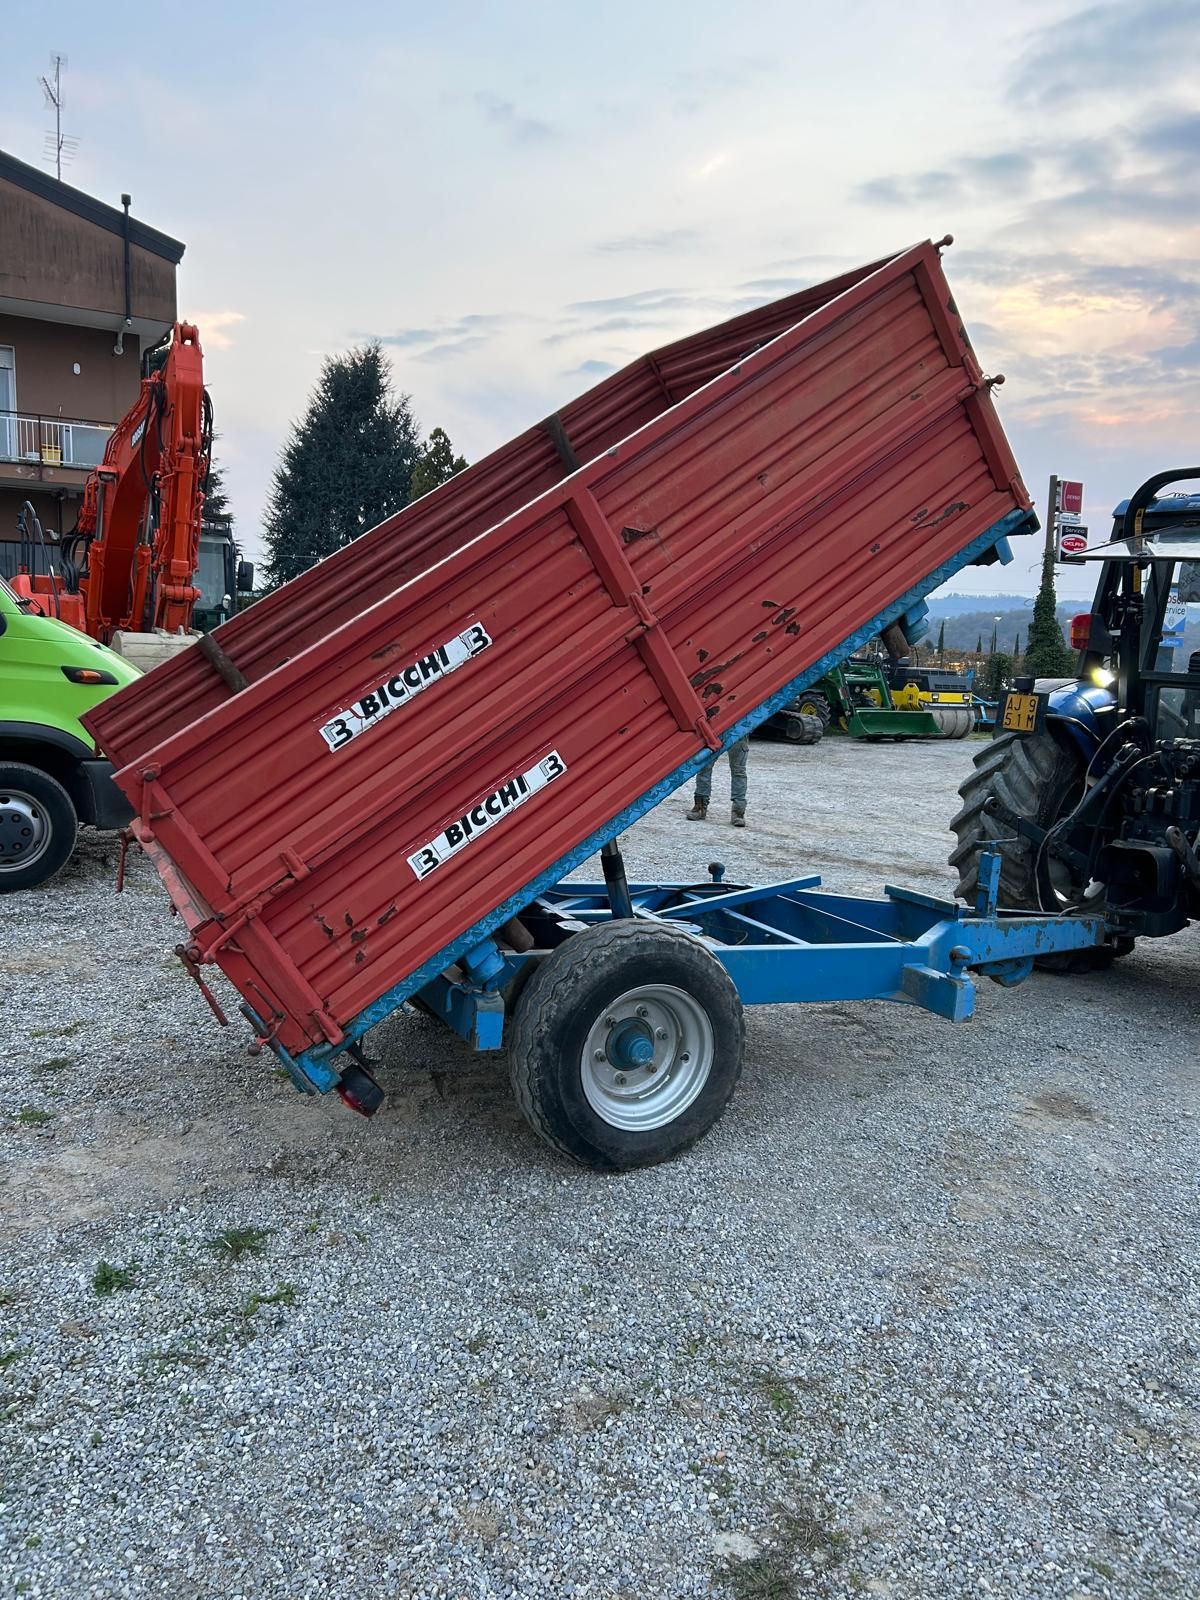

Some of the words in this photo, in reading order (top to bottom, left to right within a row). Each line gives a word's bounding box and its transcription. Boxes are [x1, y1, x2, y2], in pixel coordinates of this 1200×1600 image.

[1165, 606, 1186, 616] ervice
[359, 645, 450, 720] BICCHI
[444, 775, 527, 848] BICCHI
